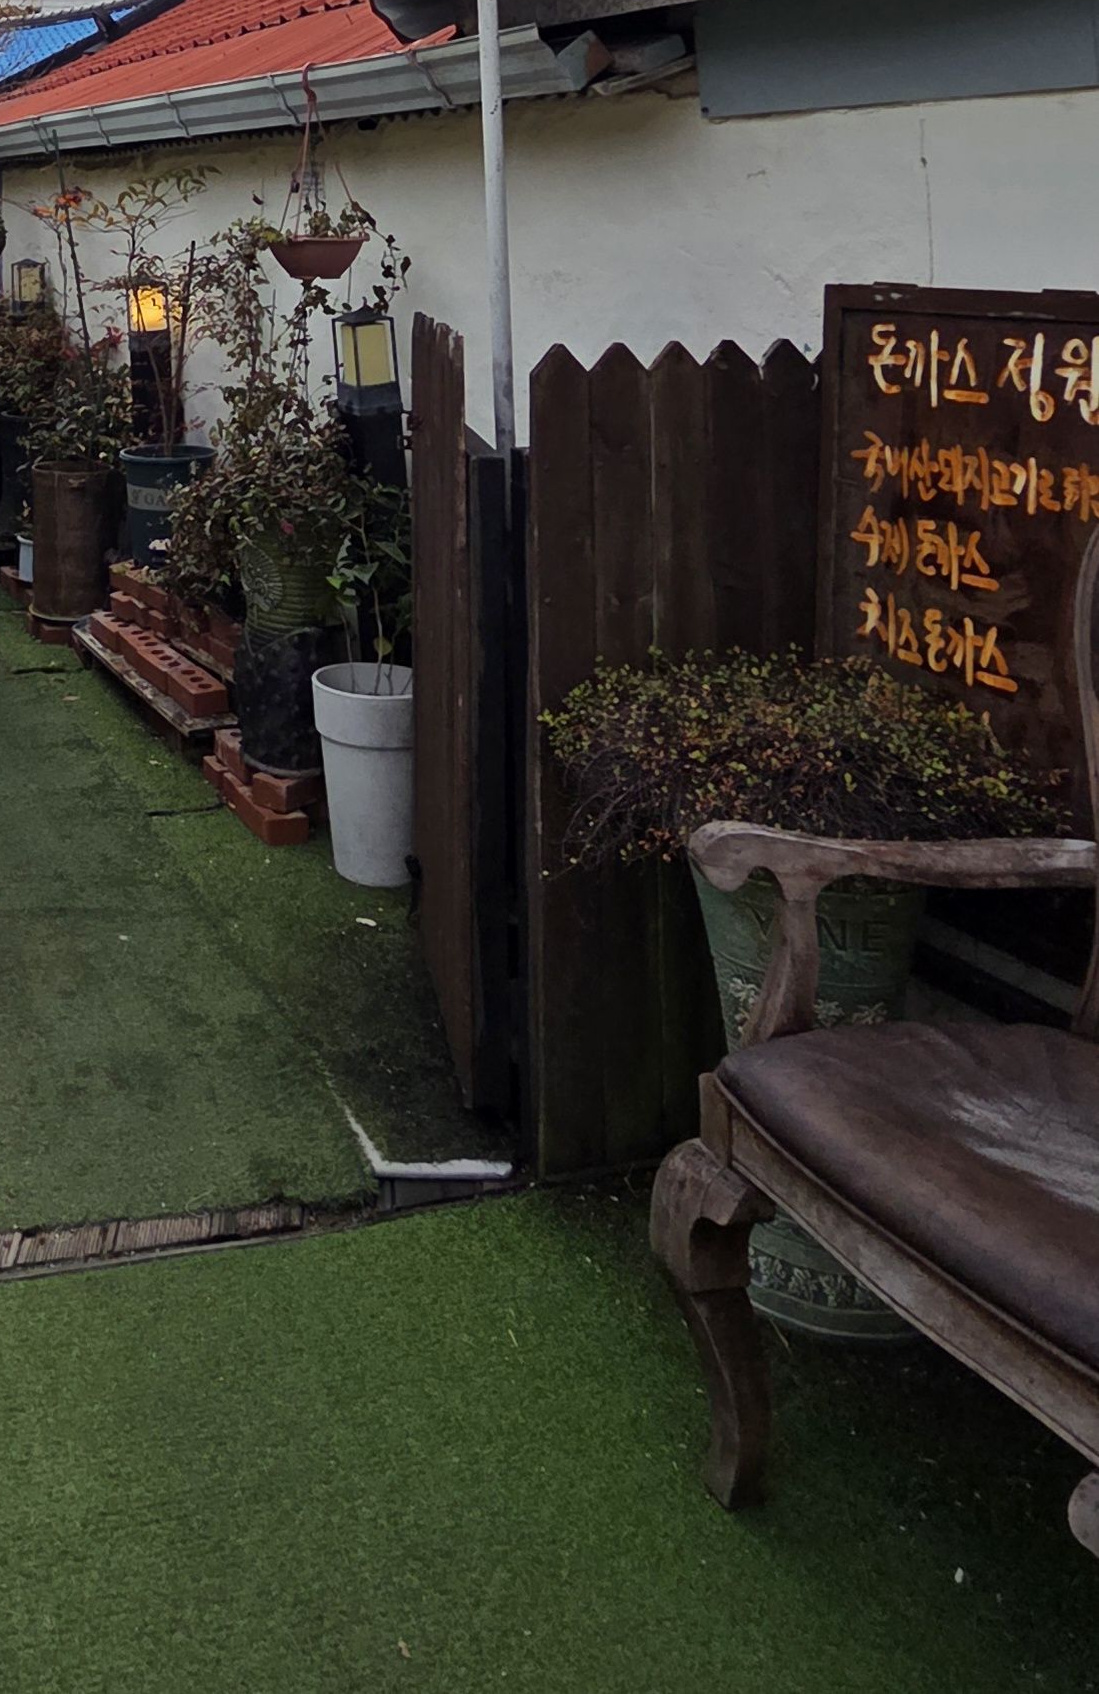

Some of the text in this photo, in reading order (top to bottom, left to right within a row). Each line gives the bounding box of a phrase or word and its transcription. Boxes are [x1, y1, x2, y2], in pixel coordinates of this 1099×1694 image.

[868, 323, 1099, 425] 돈까스 정원
[916, 519, 1000, 592] 돈까스
[743, 900, 889, 956] VNE
